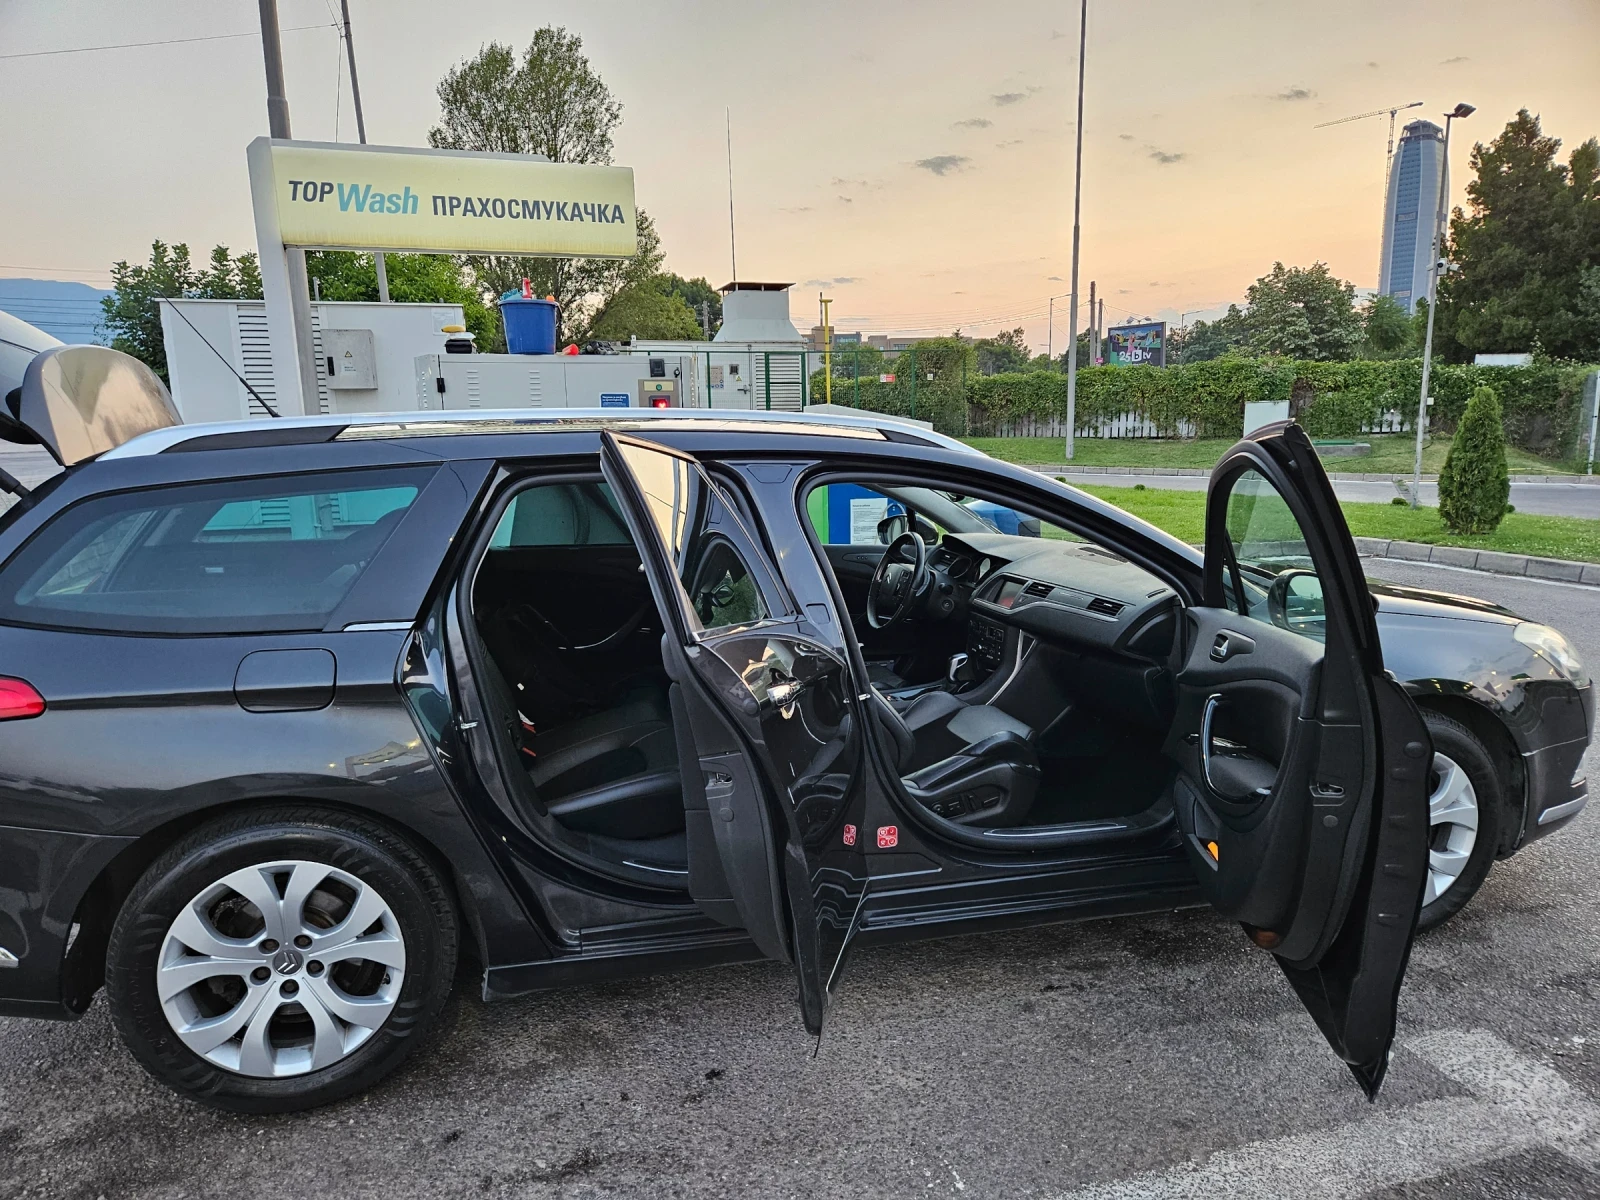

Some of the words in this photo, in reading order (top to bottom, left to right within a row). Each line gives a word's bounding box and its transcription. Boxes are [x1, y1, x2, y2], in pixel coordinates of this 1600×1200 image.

[288, 180, 335, 203] TOP
[336, 182, 419, 215] Wash
[431, 195, 626, 224] ПРАХОСМУКАЧКА
